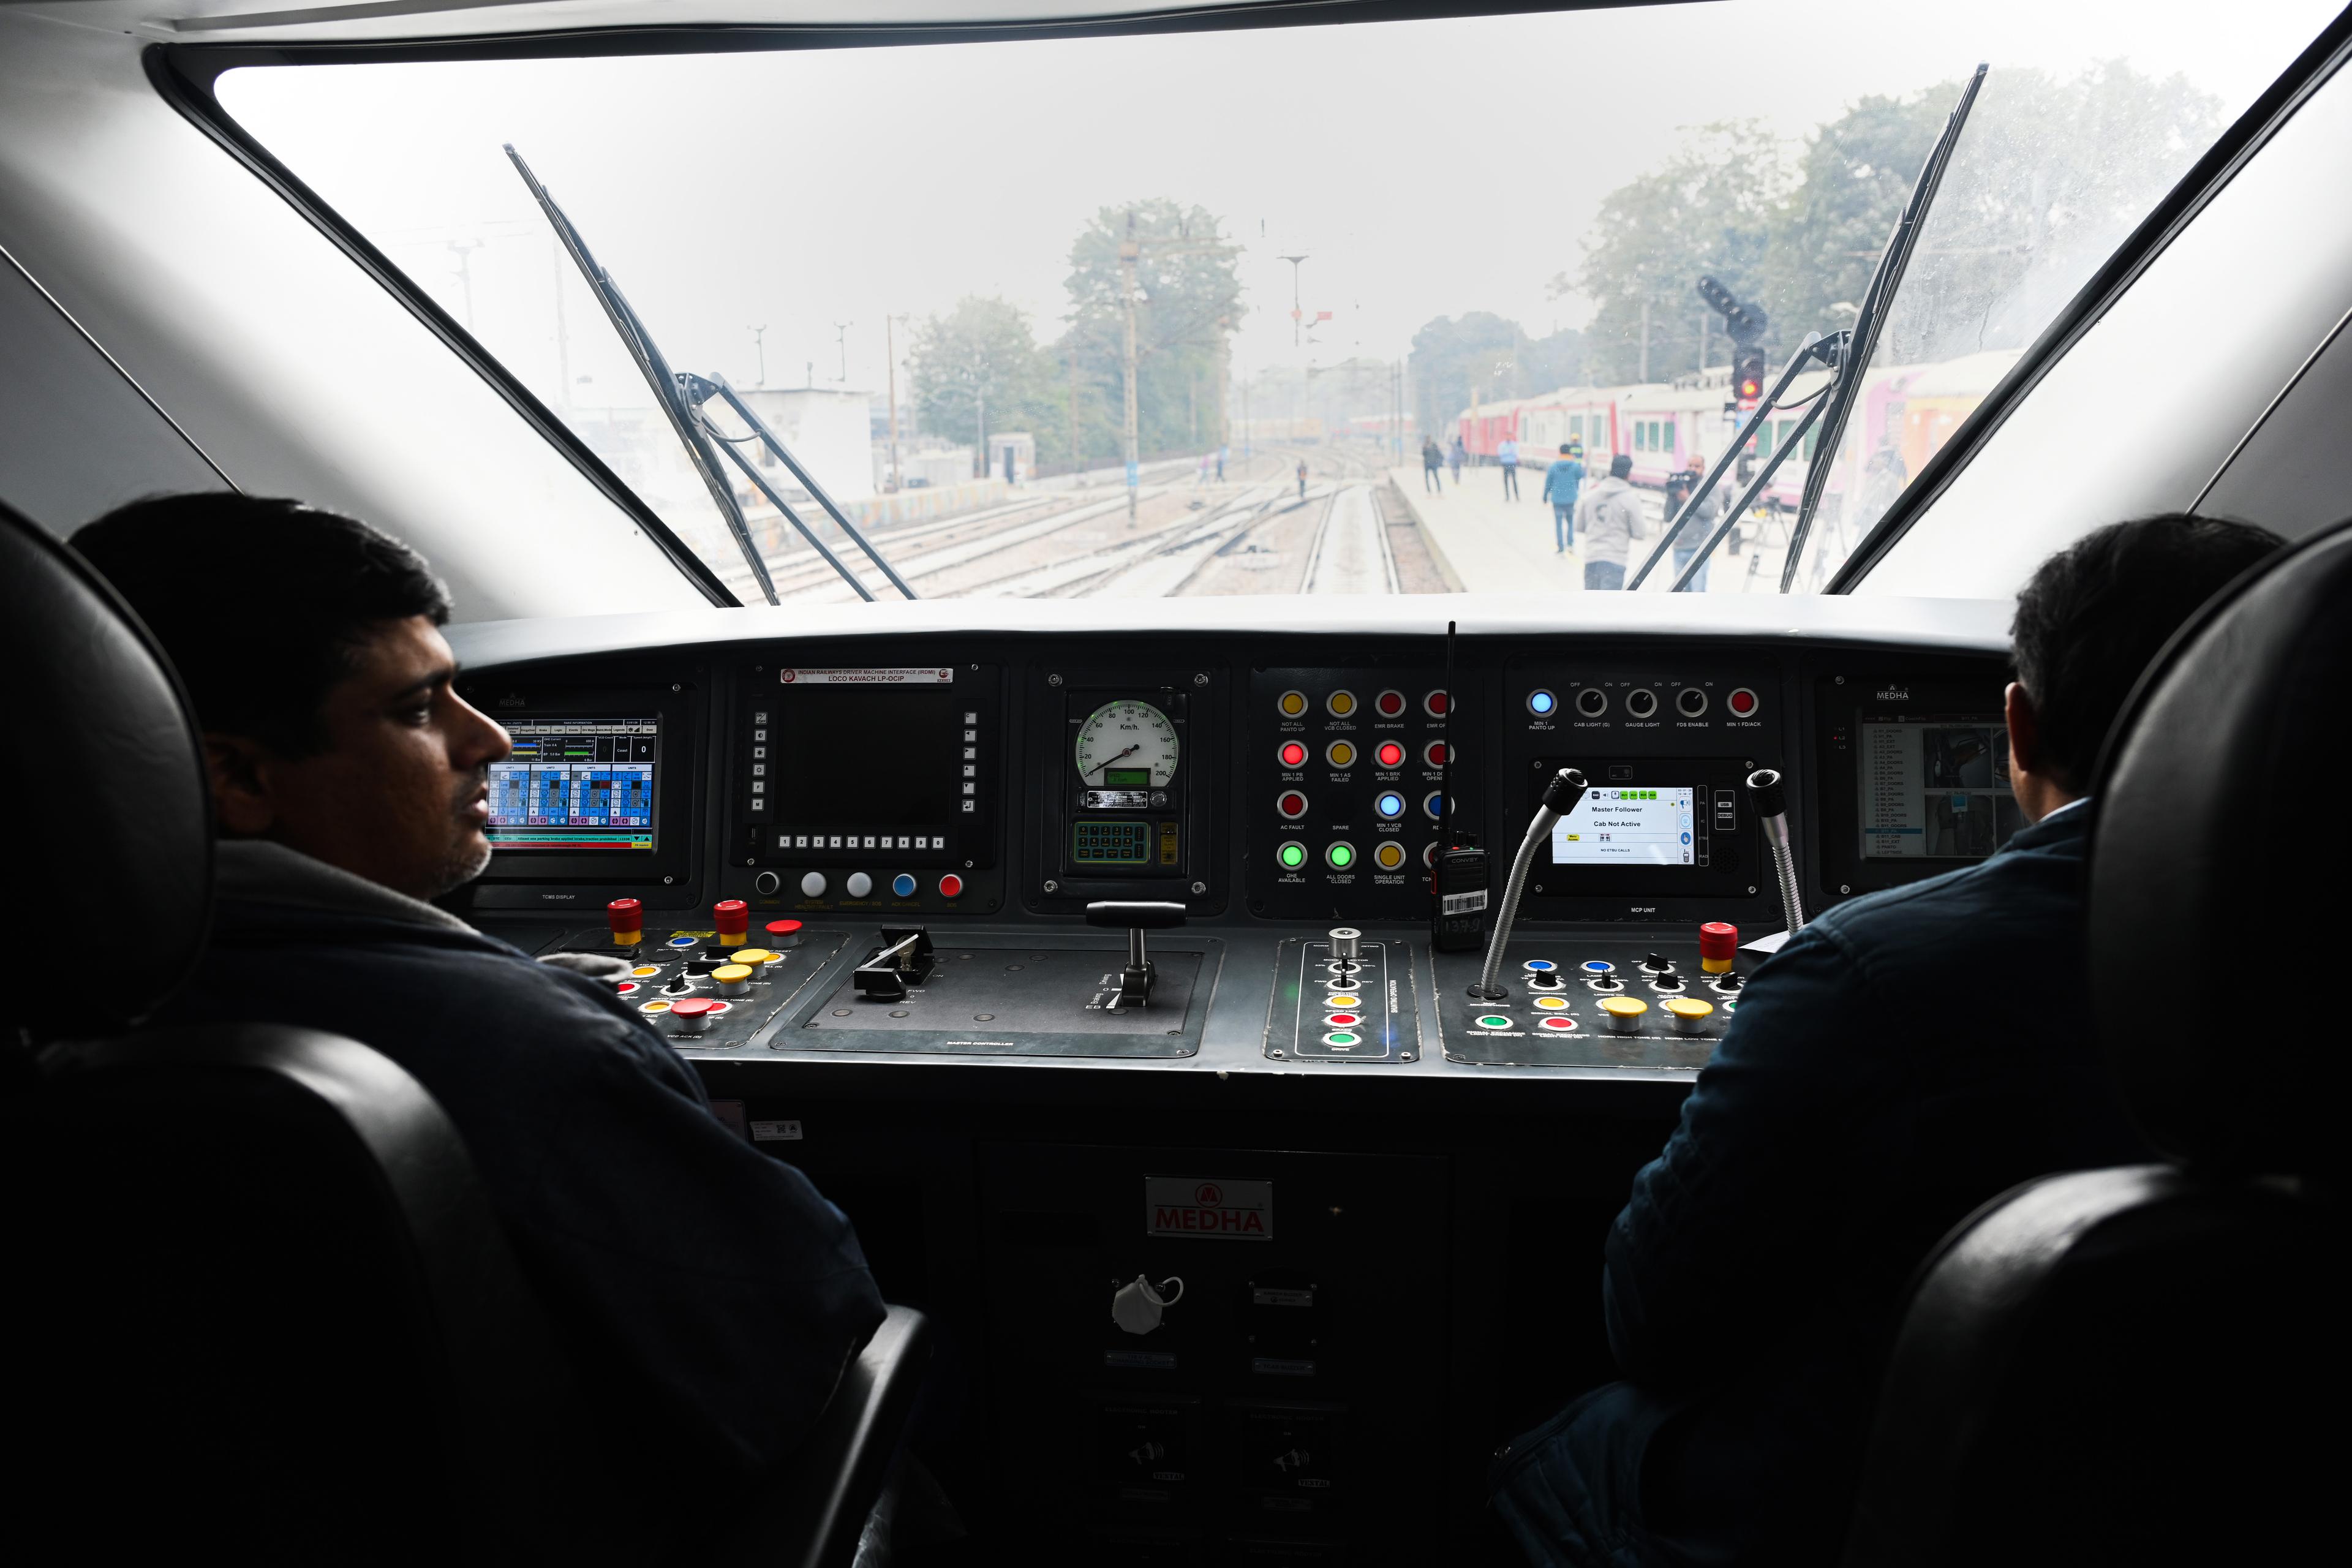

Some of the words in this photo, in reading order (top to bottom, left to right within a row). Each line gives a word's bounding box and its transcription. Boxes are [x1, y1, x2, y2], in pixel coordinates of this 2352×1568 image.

[1099, 974, 1112, 984] Driving
[1090, 993, 1104, 1004] Braking
[1155, 1208, 1265, 1232] MEDHA
